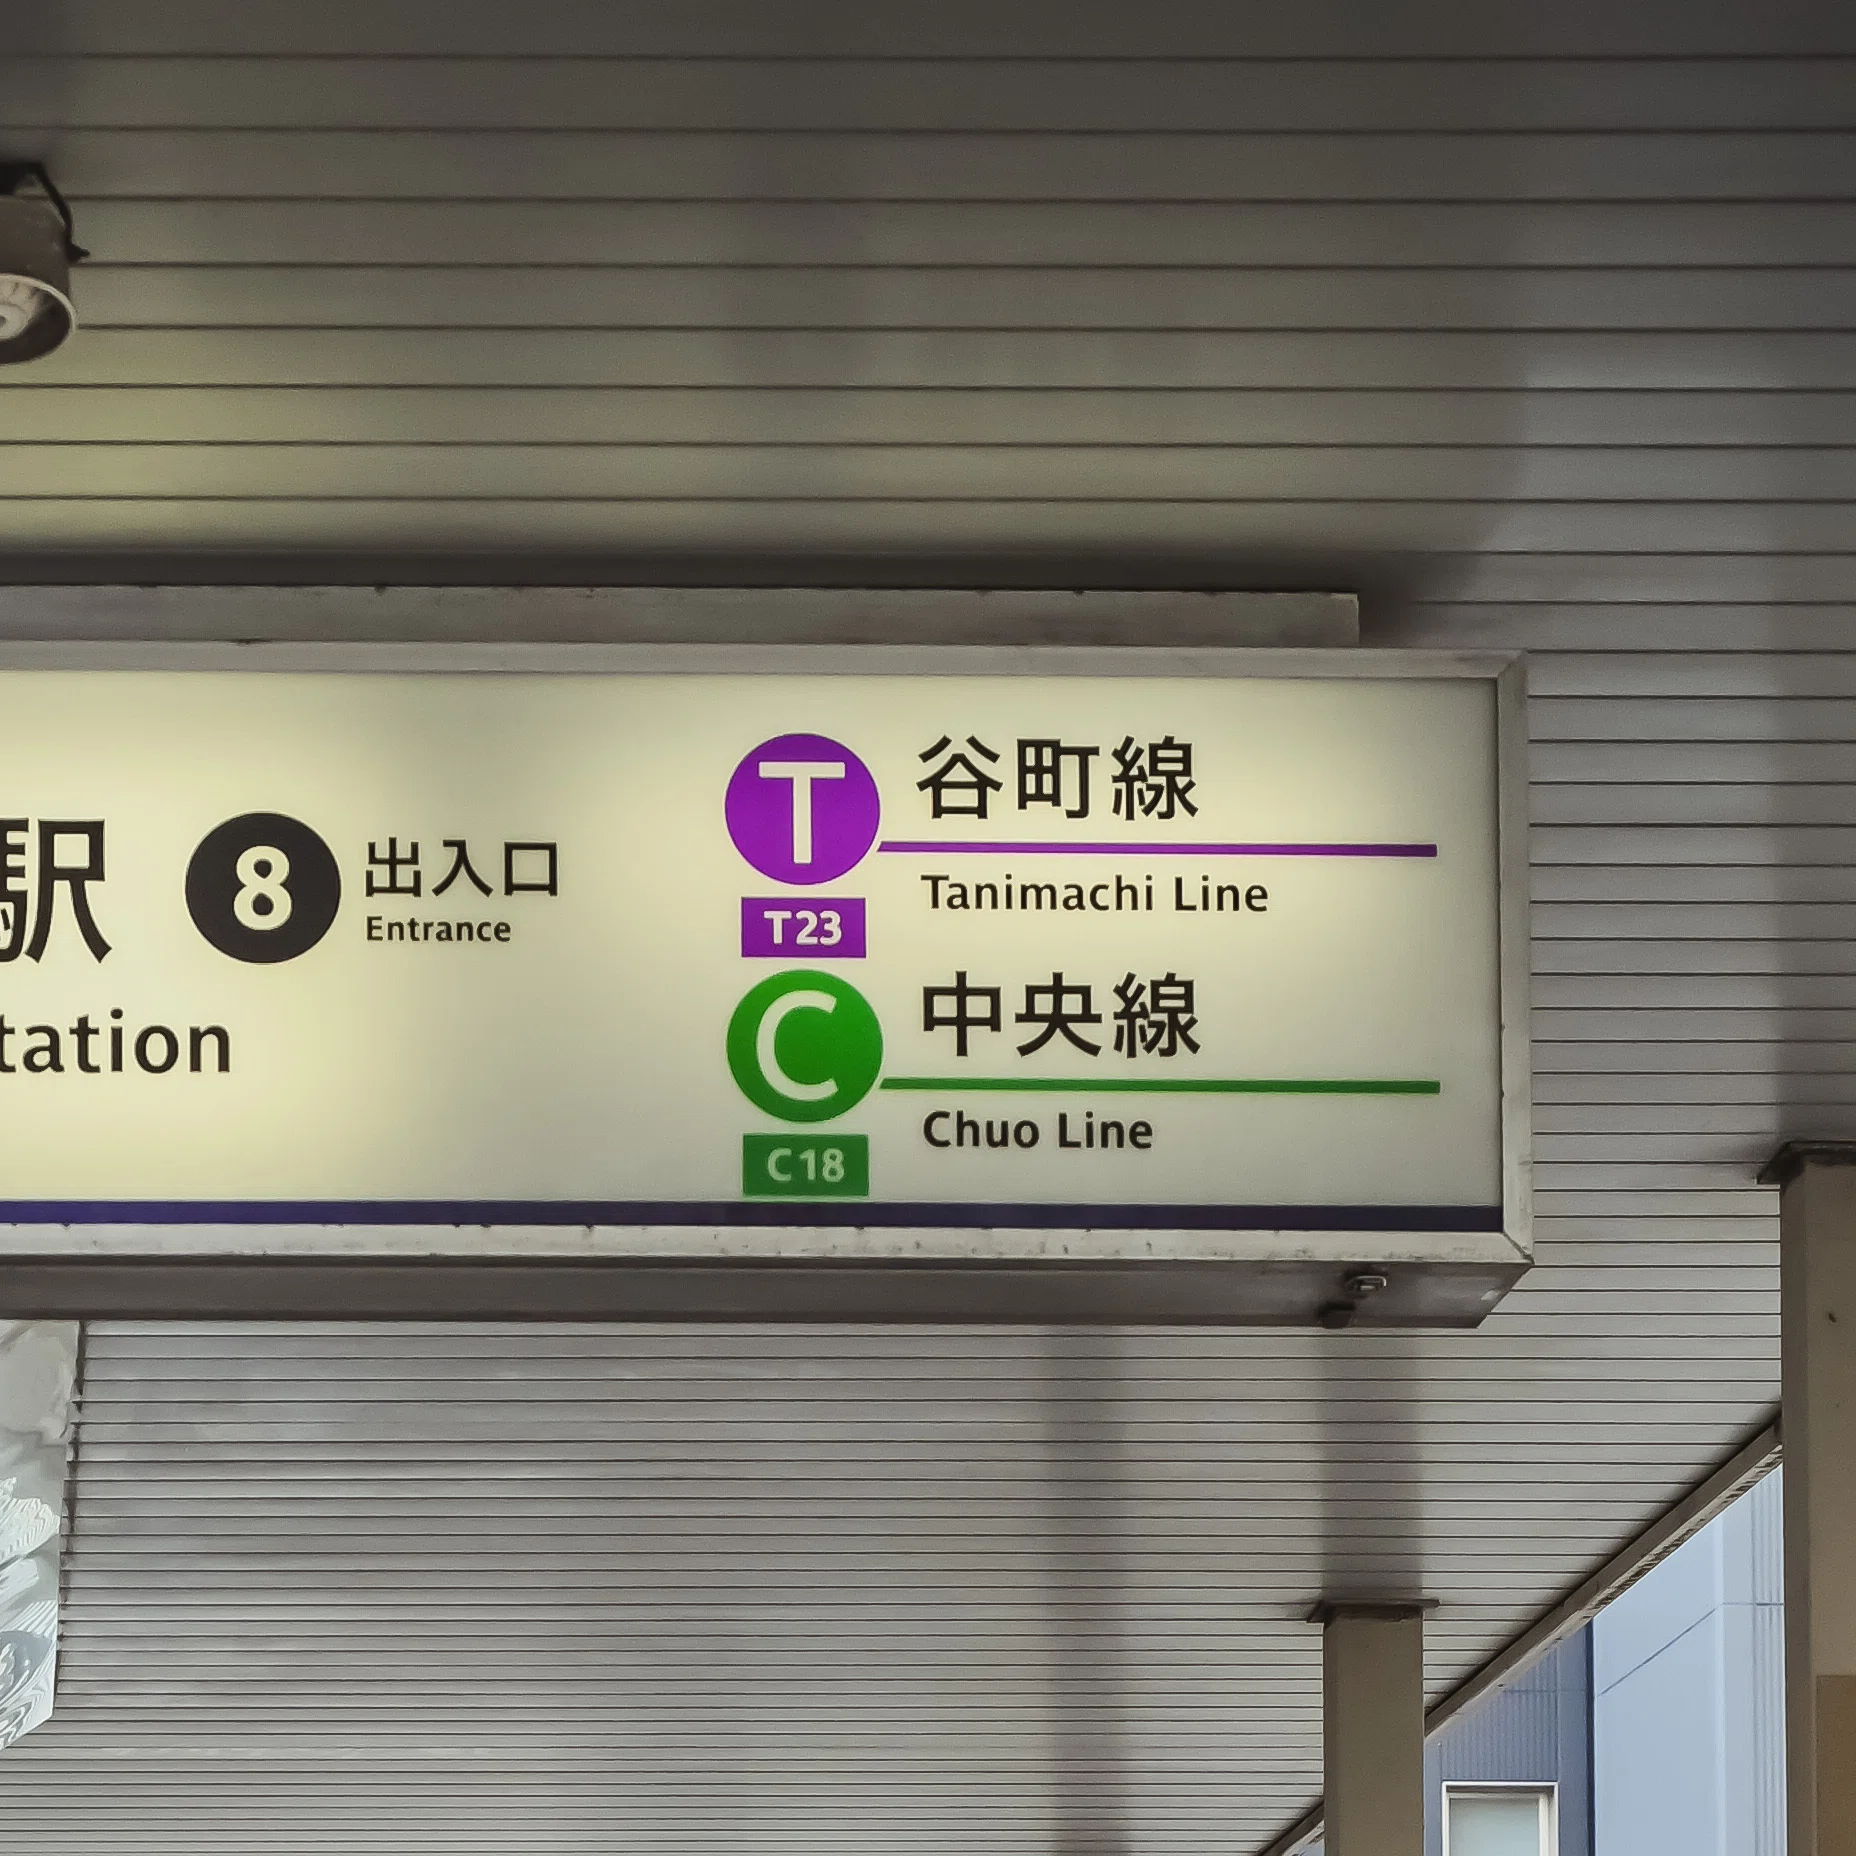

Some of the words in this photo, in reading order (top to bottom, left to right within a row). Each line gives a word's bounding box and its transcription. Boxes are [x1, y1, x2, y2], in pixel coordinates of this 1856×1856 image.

[916, 734, 1199, 821] 谷町線
[365, 836, 559, 899] 出入口
[920, 874, 1154, 913] Tanimachi
[1174, 876, 1270, 913] Line
[366, 915, 512, 943] Entrance
[762, 909, 843, 946] T23
[922, 971, 1202, 1060] 中央線
[755, 988, 839, 1101] C
[922, 1110, 1041, 1150] Chuo
[1057, 1111, 1154, 1151] Line
[766, 1147, 846, 1183] C18
